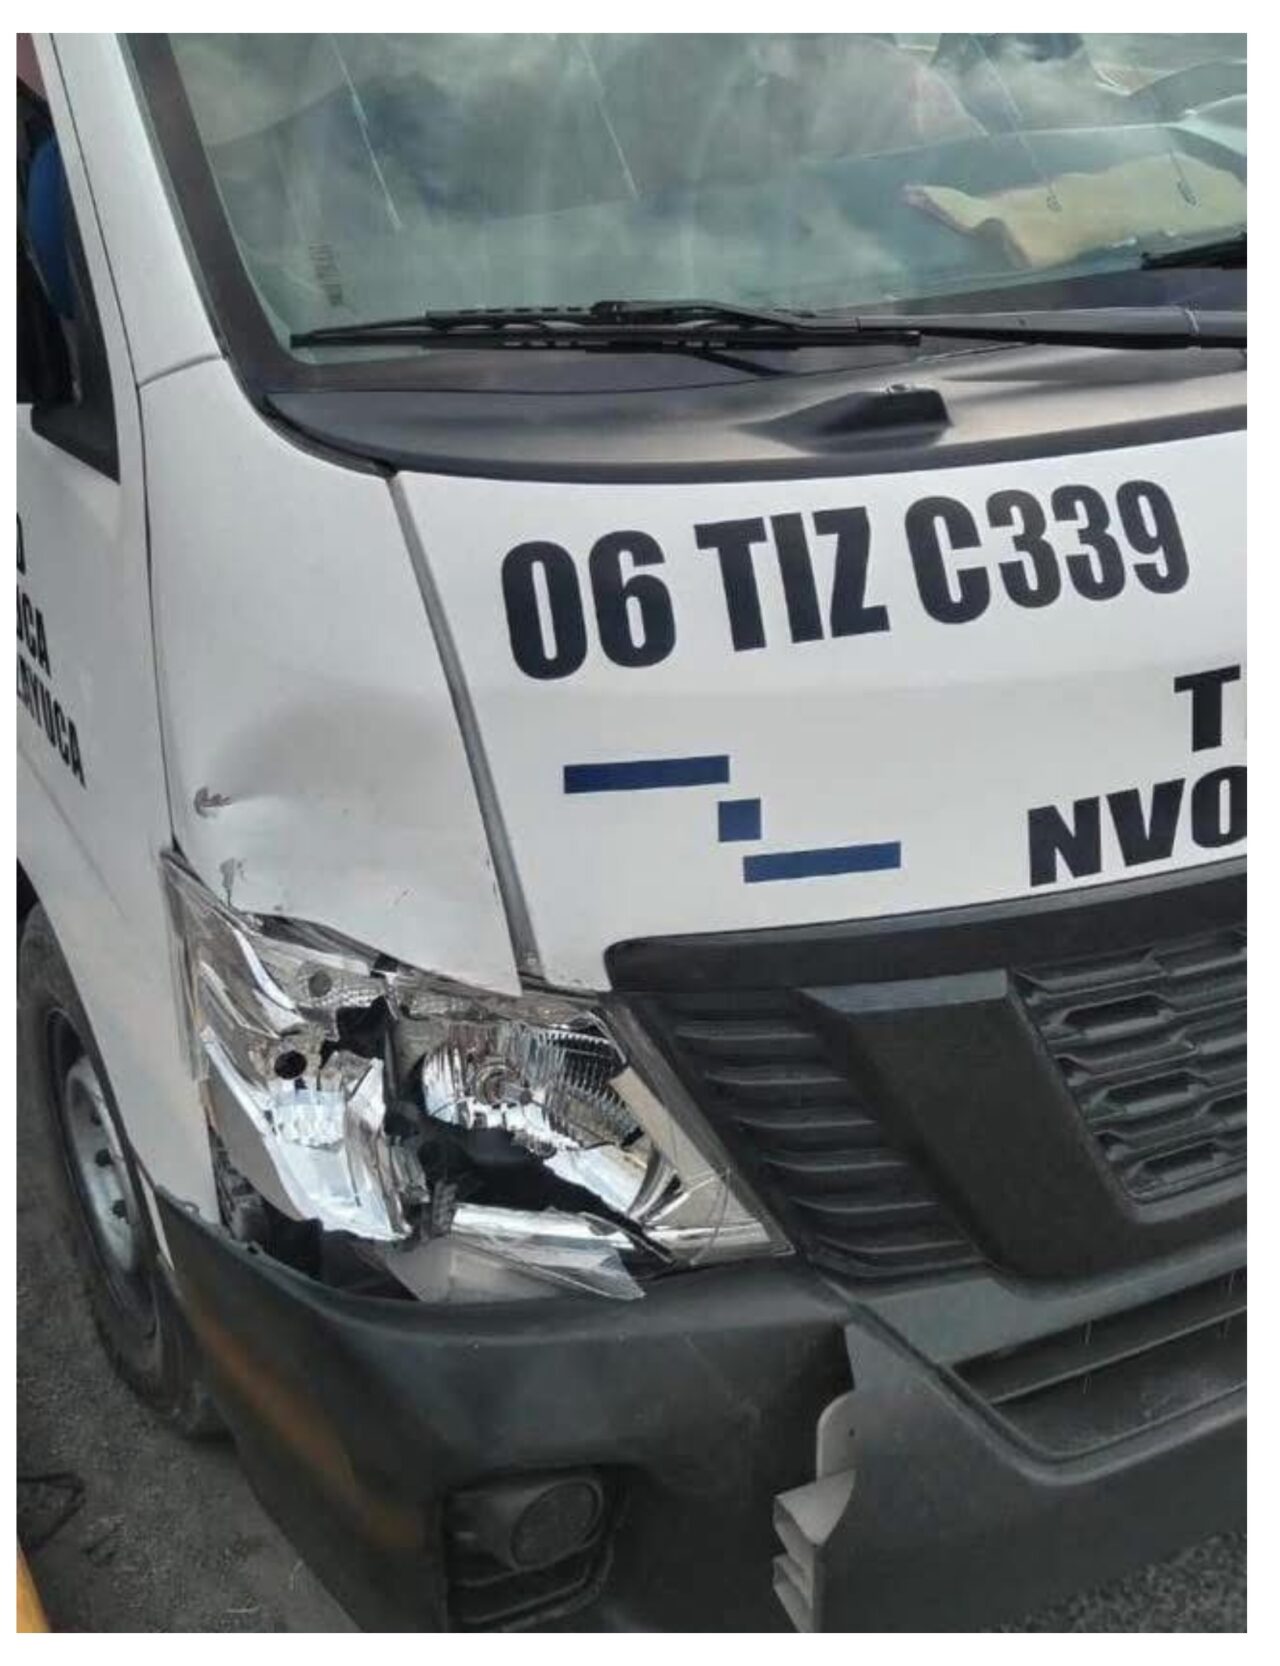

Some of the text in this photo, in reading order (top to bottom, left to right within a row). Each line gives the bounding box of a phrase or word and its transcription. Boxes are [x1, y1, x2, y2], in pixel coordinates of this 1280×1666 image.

[501, 480, 1190, 680] 06 TIZ C339
[1027, 764, 1248, 878] NVO
